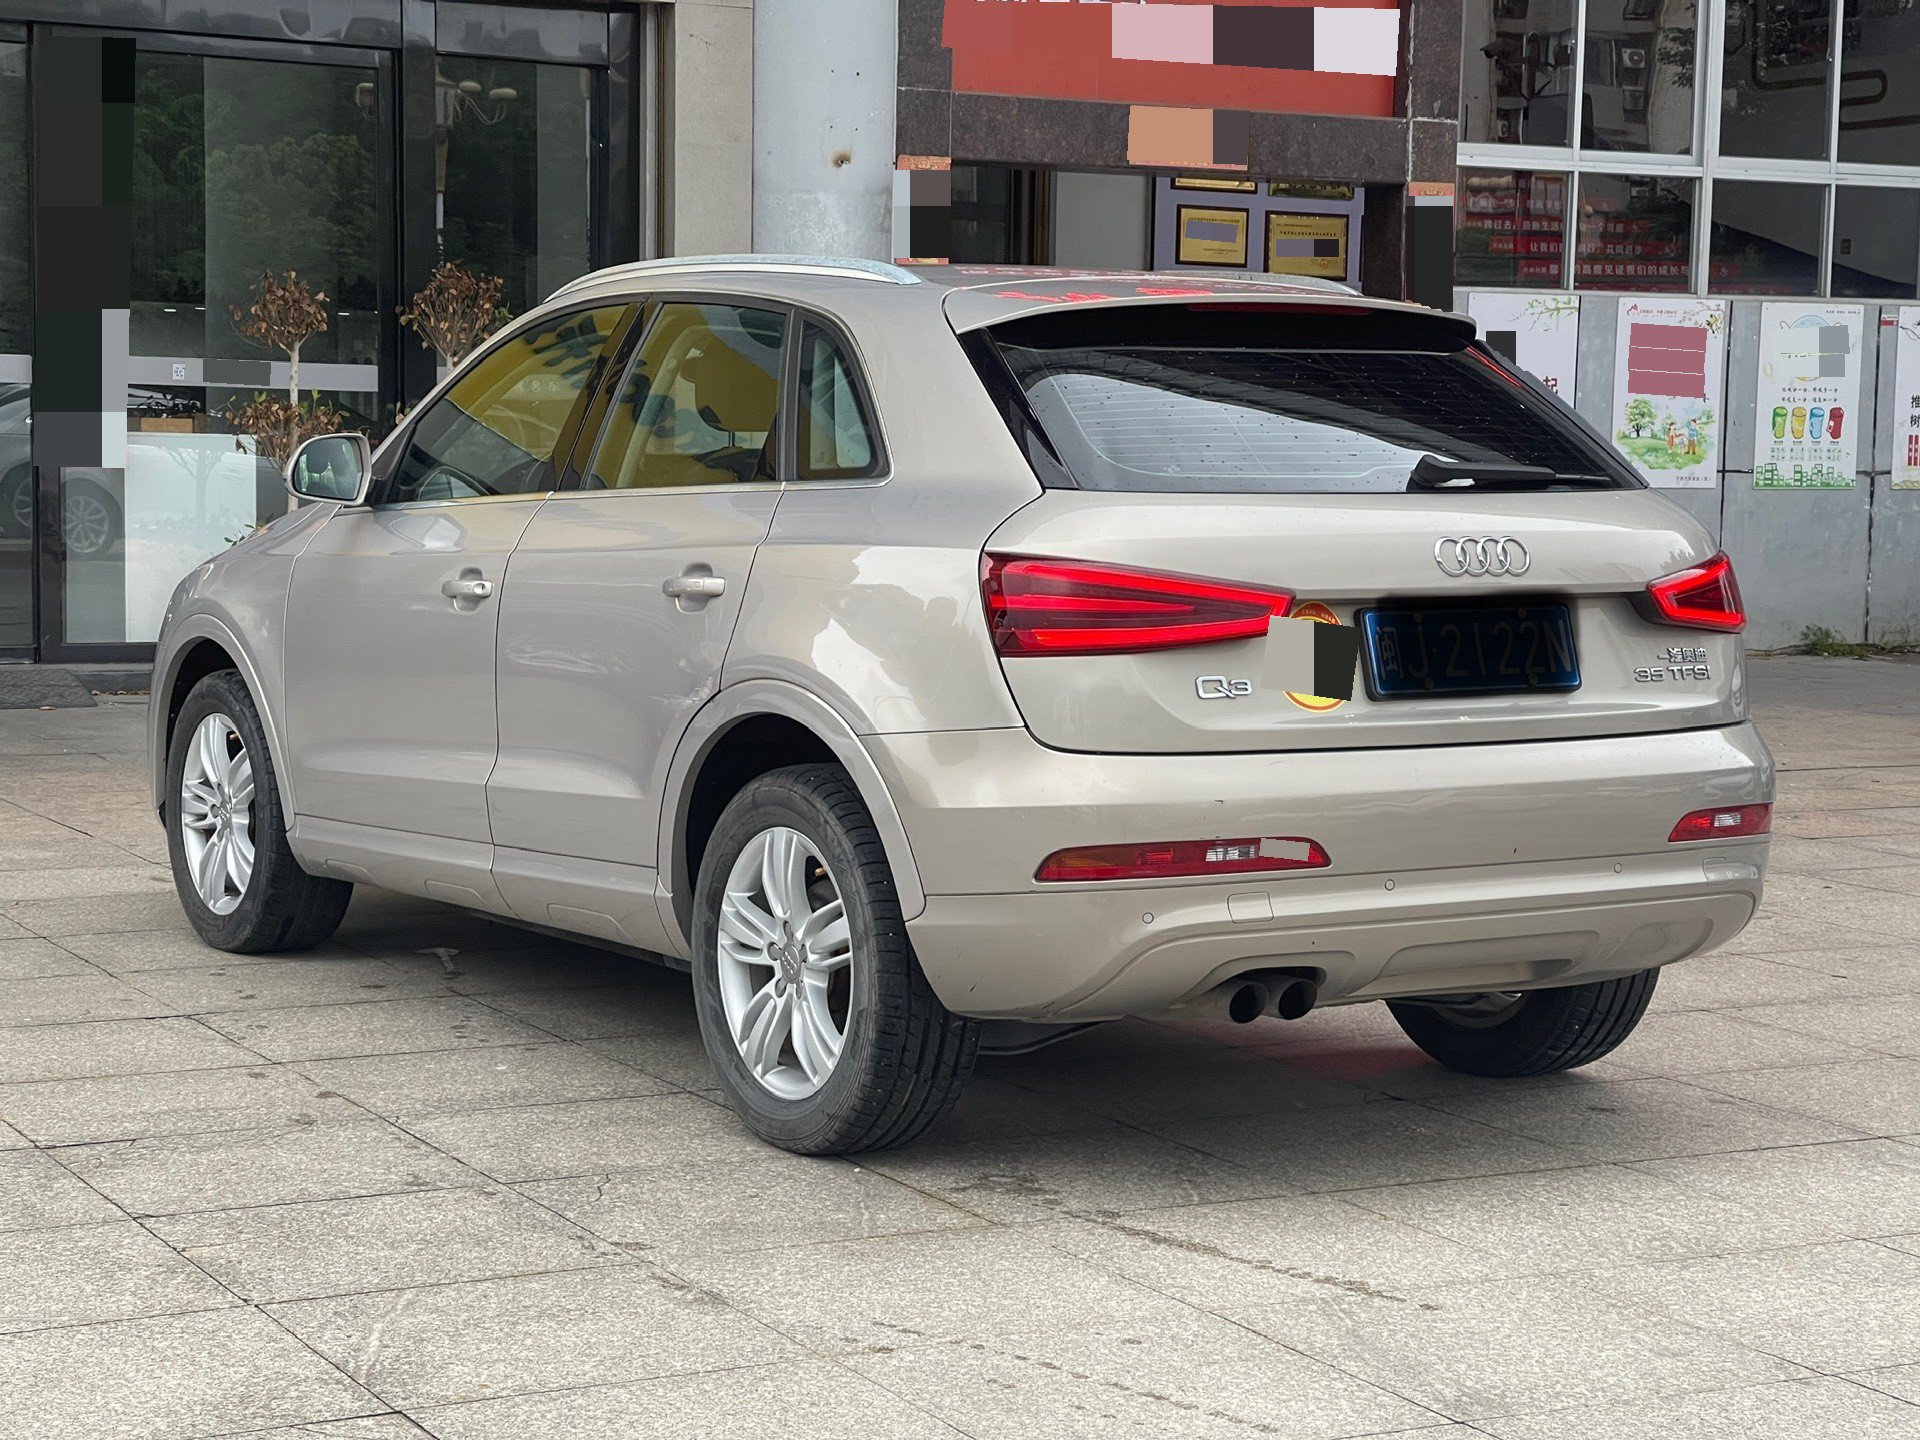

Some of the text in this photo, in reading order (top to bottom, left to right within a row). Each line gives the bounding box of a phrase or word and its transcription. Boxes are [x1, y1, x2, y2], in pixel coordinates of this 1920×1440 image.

[1657, 647, 1707, 663] 一汽奥迪
[1634, 665, 1711, 682] 35 TFSI
[1195, 675, 1253, 699] Q3
